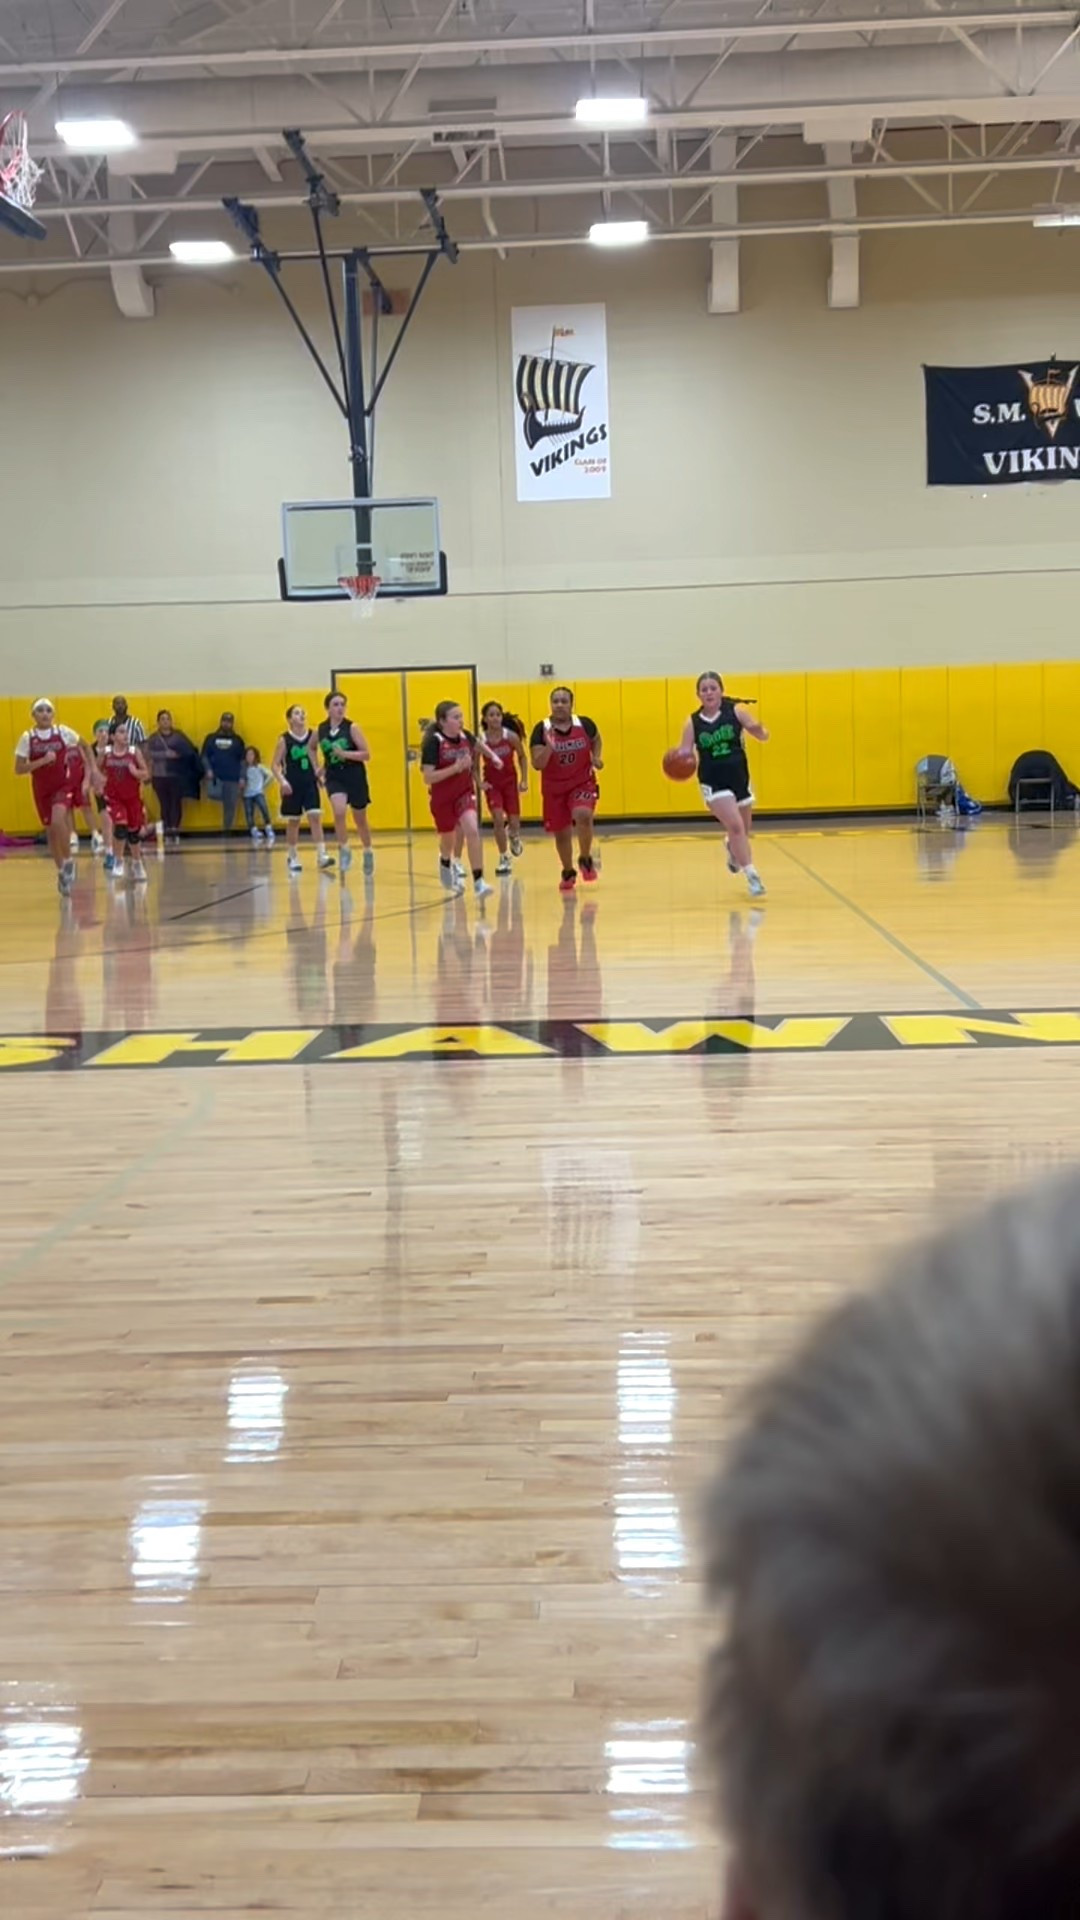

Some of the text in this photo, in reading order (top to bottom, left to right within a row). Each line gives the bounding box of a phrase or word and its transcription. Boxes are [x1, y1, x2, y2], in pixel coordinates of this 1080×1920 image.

[972, 402, 1026, 424] S.M.
[530, 424, 607, 477] VIKINGS
[983, 446, 1080, 475] VIKIN
[559, 752, 576, 766] 20
